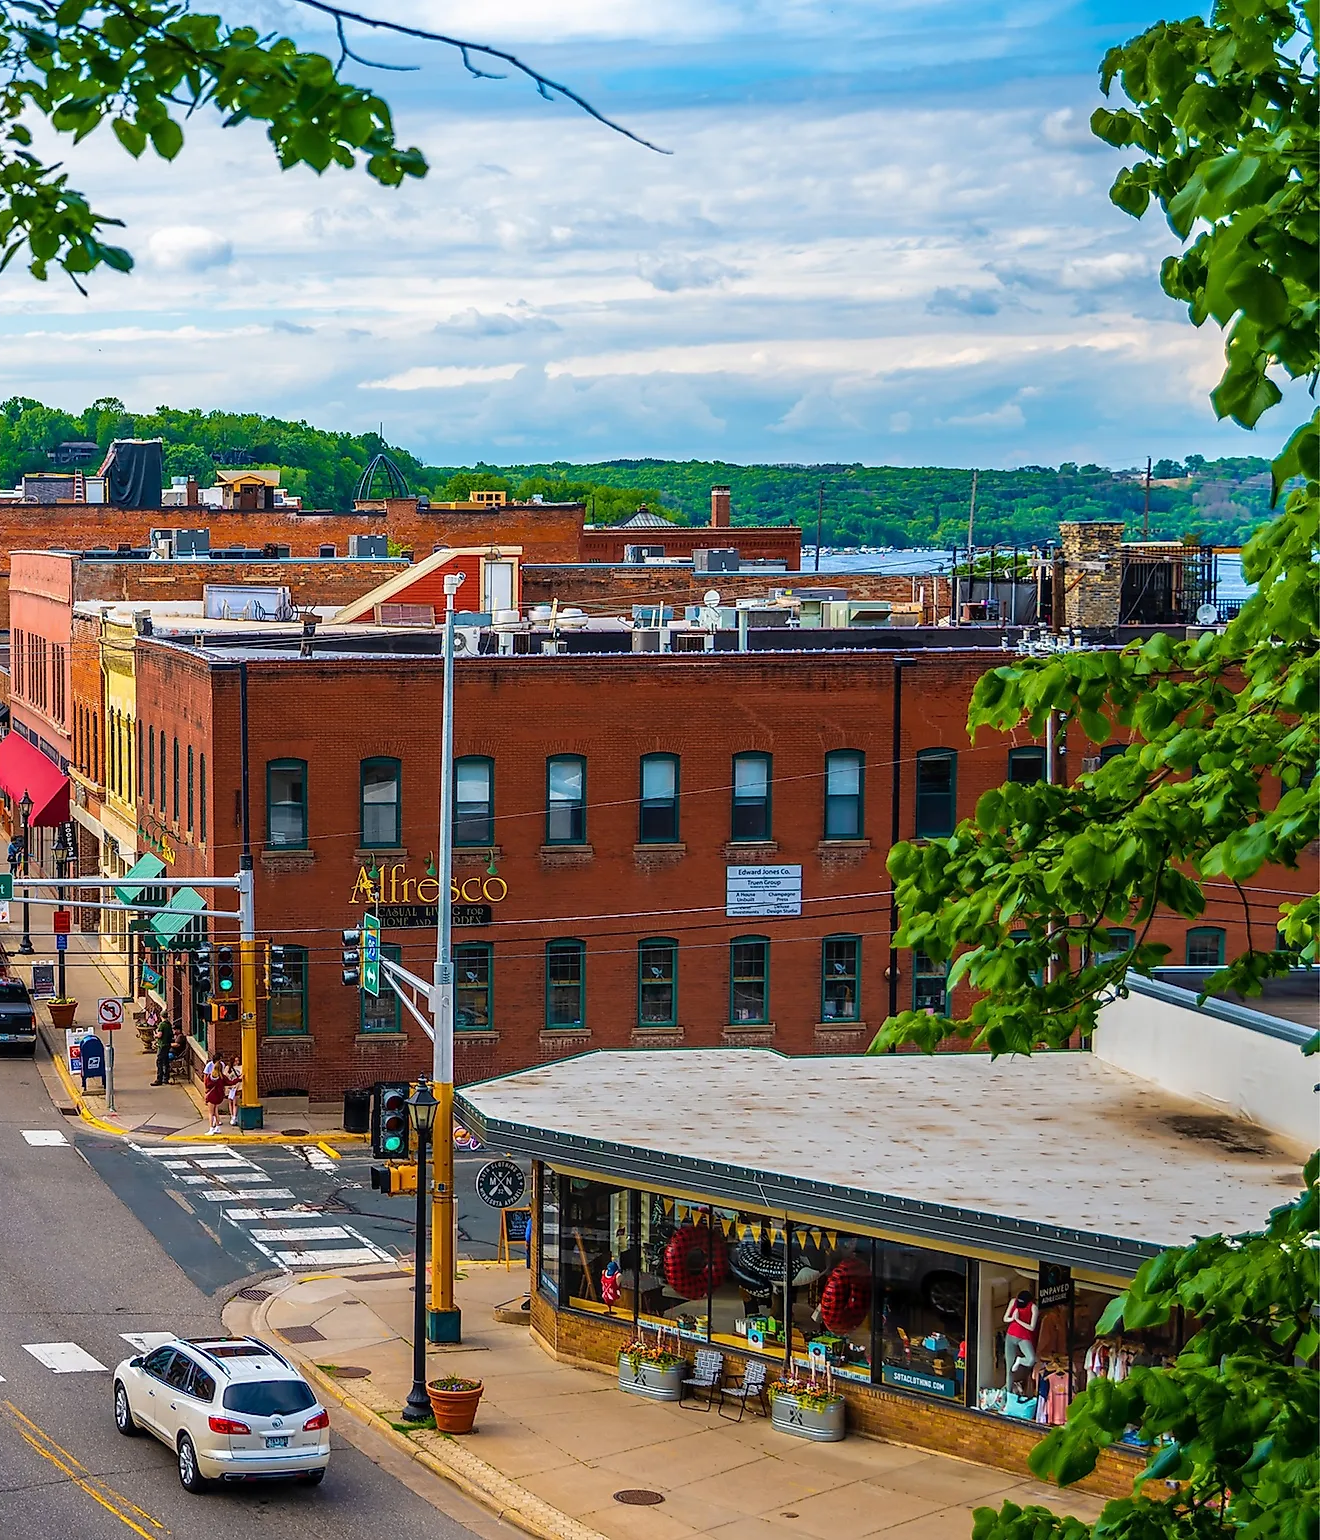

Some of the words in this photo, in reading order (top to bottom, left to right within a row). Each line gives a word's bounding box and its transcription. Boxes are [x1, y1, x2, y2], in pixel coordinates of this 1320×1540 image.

[348, 863, 508, 904] Alfresco
[378, 906, 418, 918] CASUAL
[1040, 1284, 1070, 1297] UNPAVED
[893, 1372, 945, 1391] SOTACLOTHING.COM
